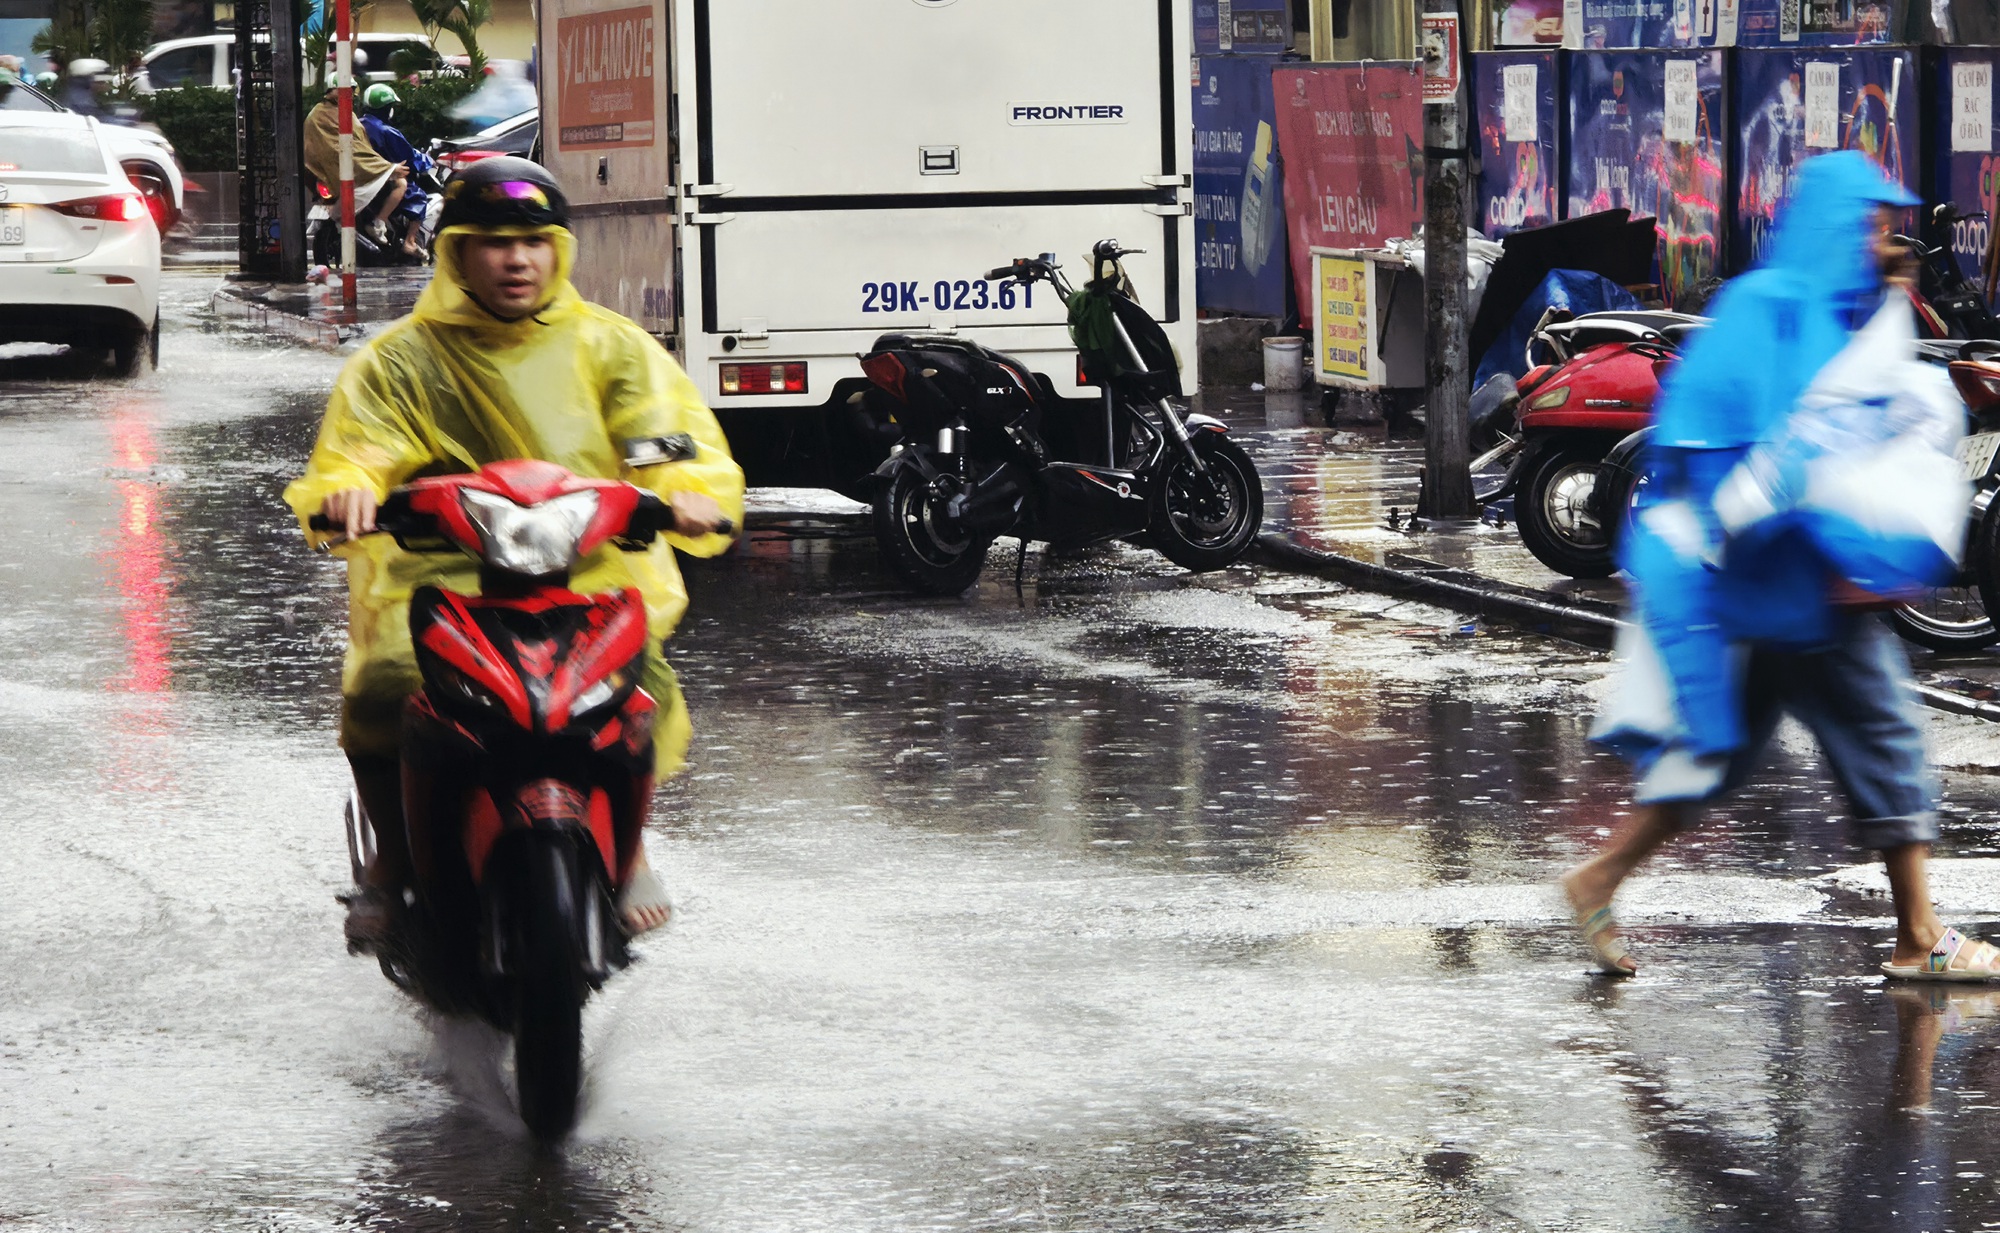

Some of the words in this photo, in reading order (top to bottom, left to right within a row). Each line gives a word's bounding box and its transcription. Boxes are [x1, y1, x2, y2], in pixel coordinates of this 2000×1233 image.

[574, 17, 652, 84] LALAMOVE
[1013, 105, 1123, 120] FRONTIER
[1319, 185, 1345, 233] LÊN
[861, 279, 1032, 313] 29K-023.61
